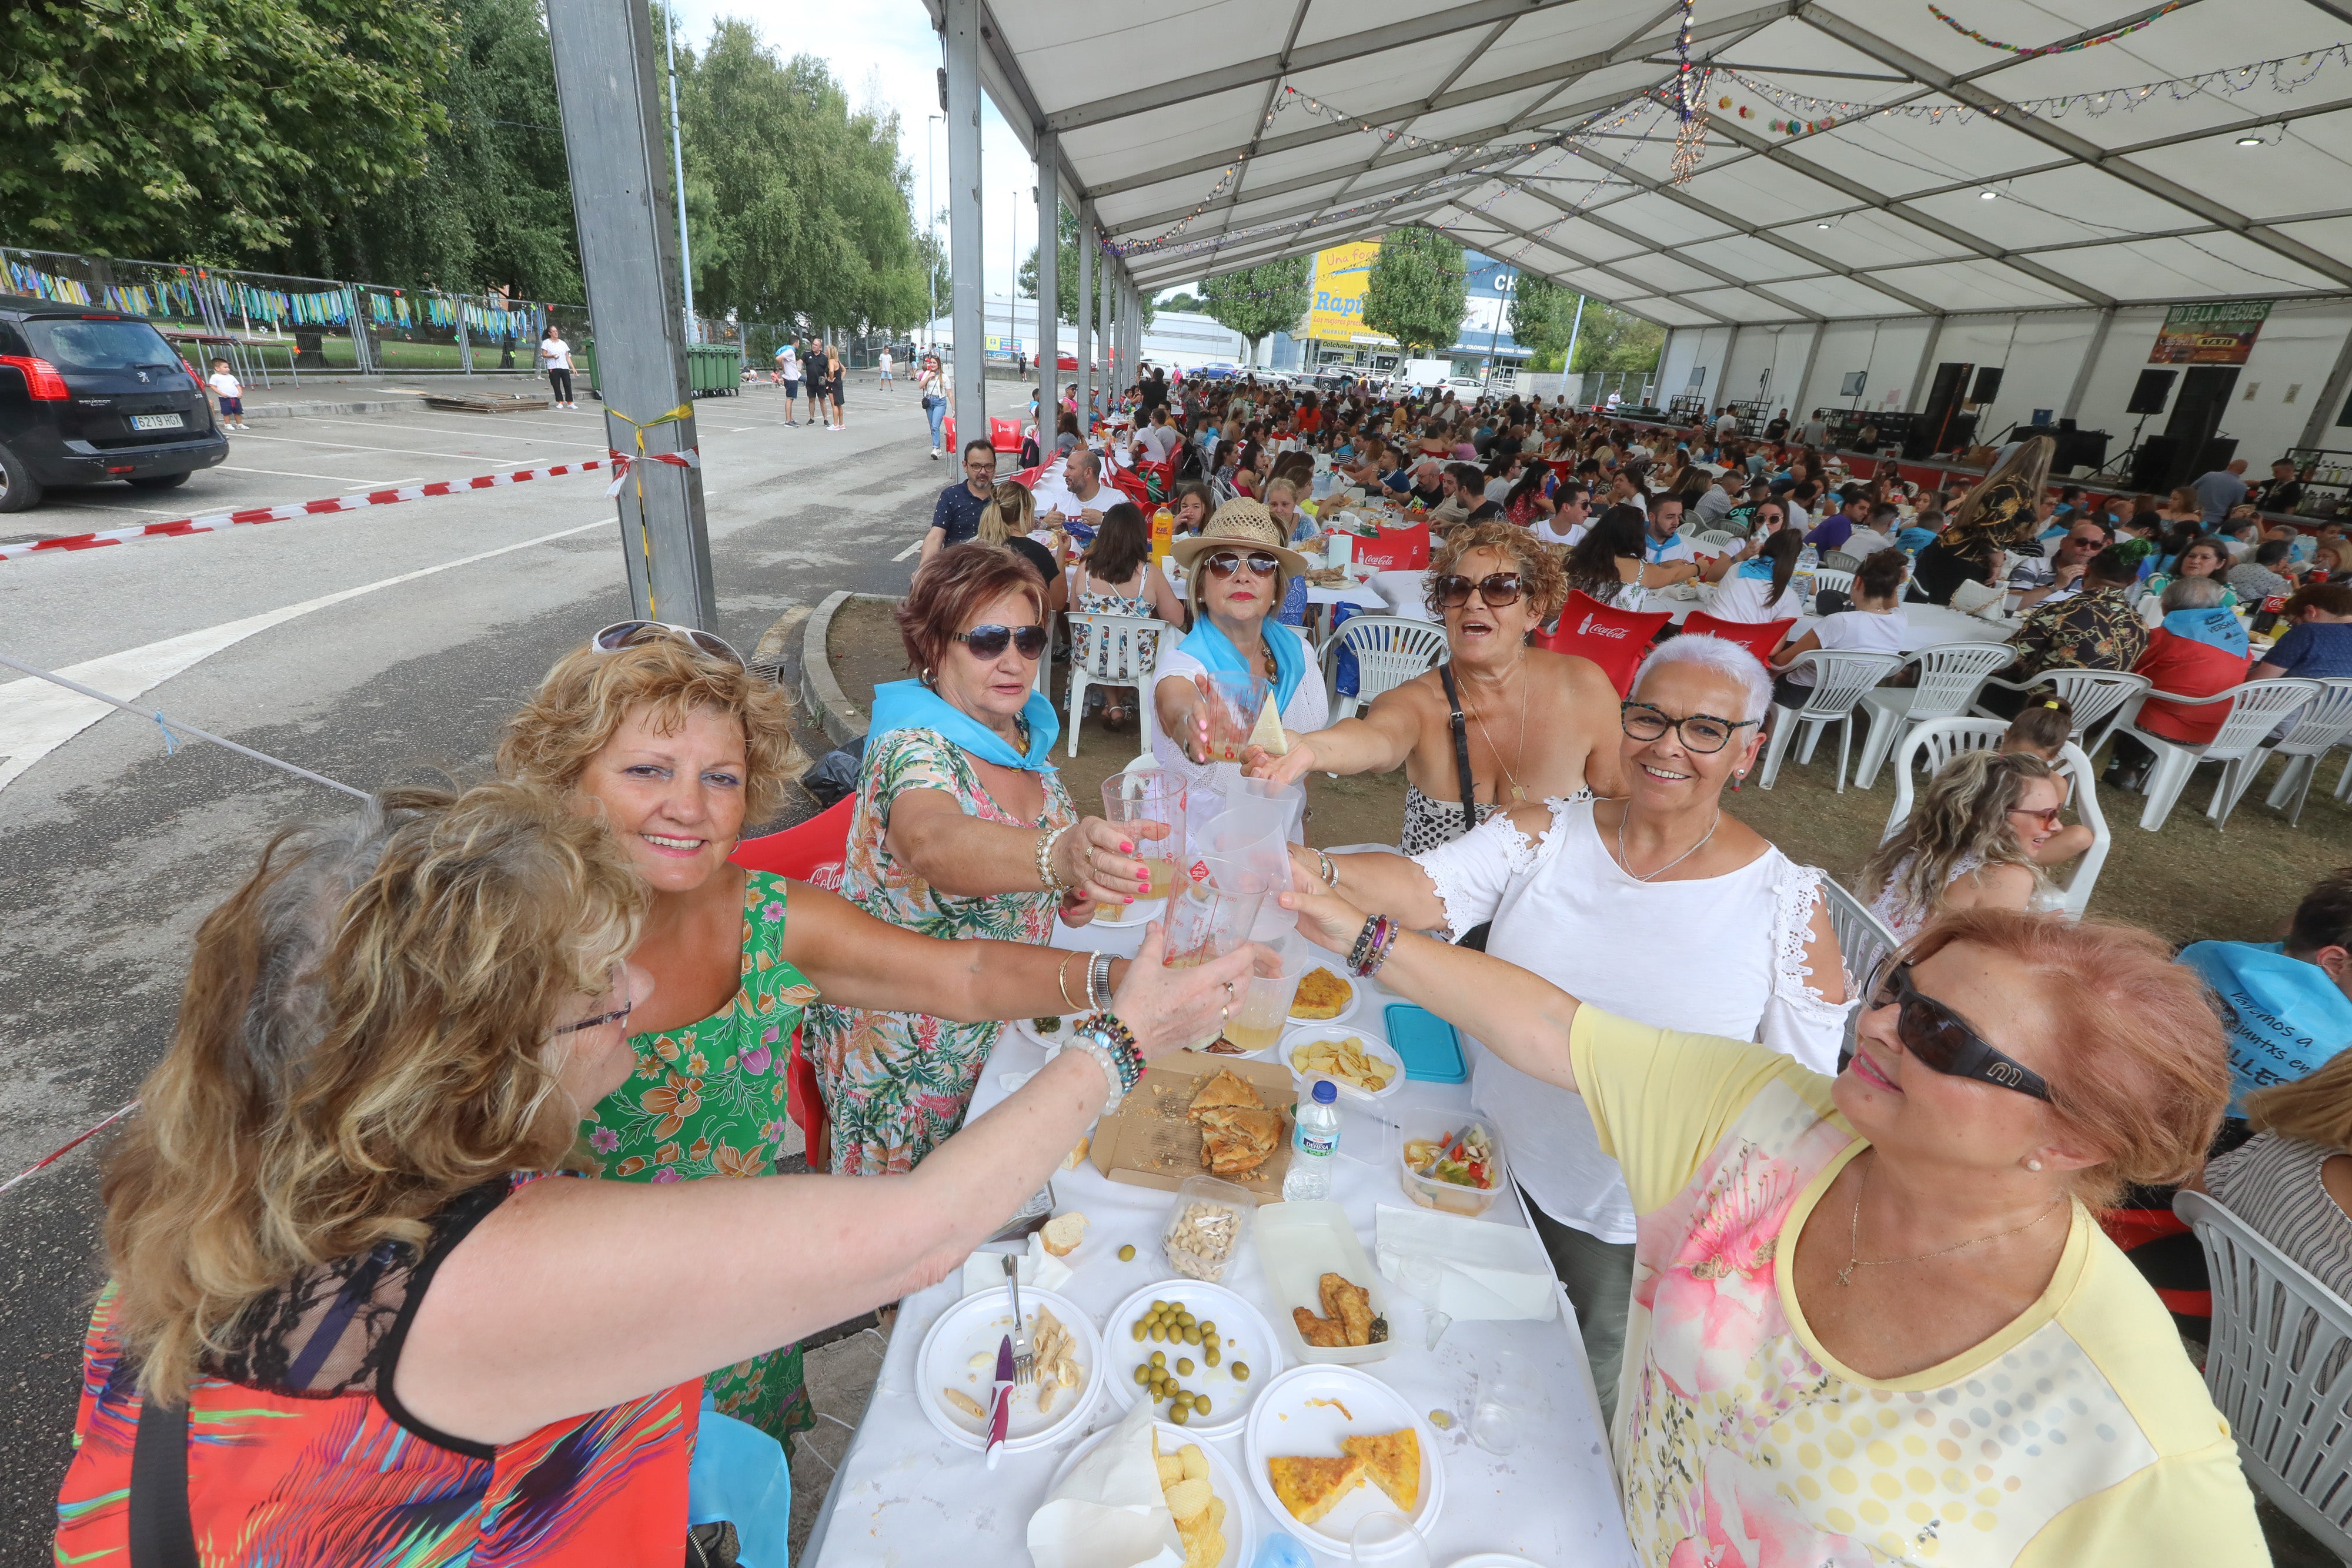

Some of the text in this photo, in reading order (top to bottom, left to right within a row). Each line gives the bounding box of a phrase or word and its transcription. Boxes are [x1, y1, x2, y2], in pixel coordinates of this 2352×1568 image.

[1327, 253, 1348, 266] Una
[2169, 304, 2267, 322] NO TE LA JUEGUES
[1323, 341, 1354, 350] Colchones
[1466, 343, 1489, 352] COLCHONES
[138, 414, 181, 427] 6219 HGX
[2233, 1021, 2311, 1074] juntxs en
[2296, 1038, 2313, 1048] a
[1306, 1141, 1329, 1151] DEHESA
